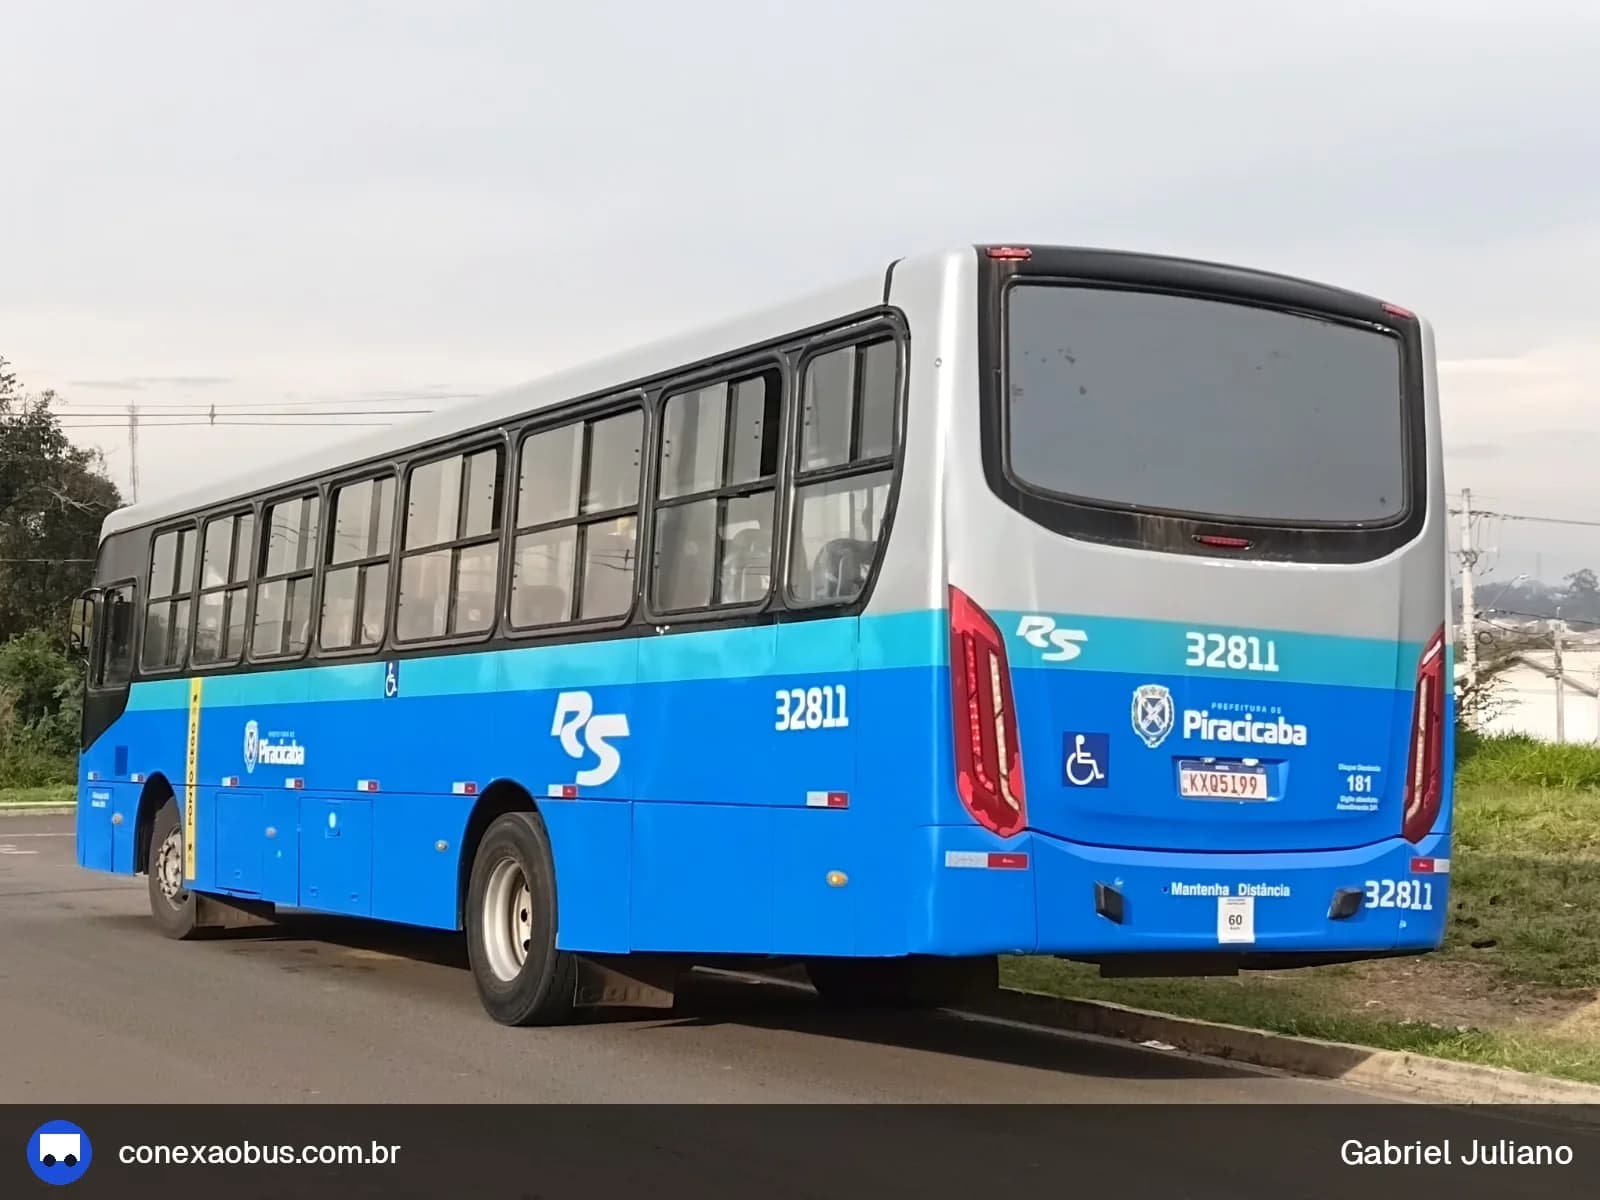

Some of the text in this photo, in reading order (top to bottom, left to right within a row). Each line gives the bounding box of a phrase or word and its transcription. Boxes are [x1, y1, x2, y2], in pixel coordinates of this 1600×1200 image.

[1015, 615, 1088, 661] RS
[1185, 632, 1279, 672] 32811
[775, 683, 849, 731] 32811
[551, 690, 630, 786] RS
[1183, 709, 1307, 746] Piracicaba
[1190, 773, 1258, 795] KXQ5199
[1346, 774, 1372, 793] 181
[1171, 882, 1290, 896] Mantenha Distância
[1364, 879, 1433, 910] 32811
[1228, 914, 1243, 926] 60
